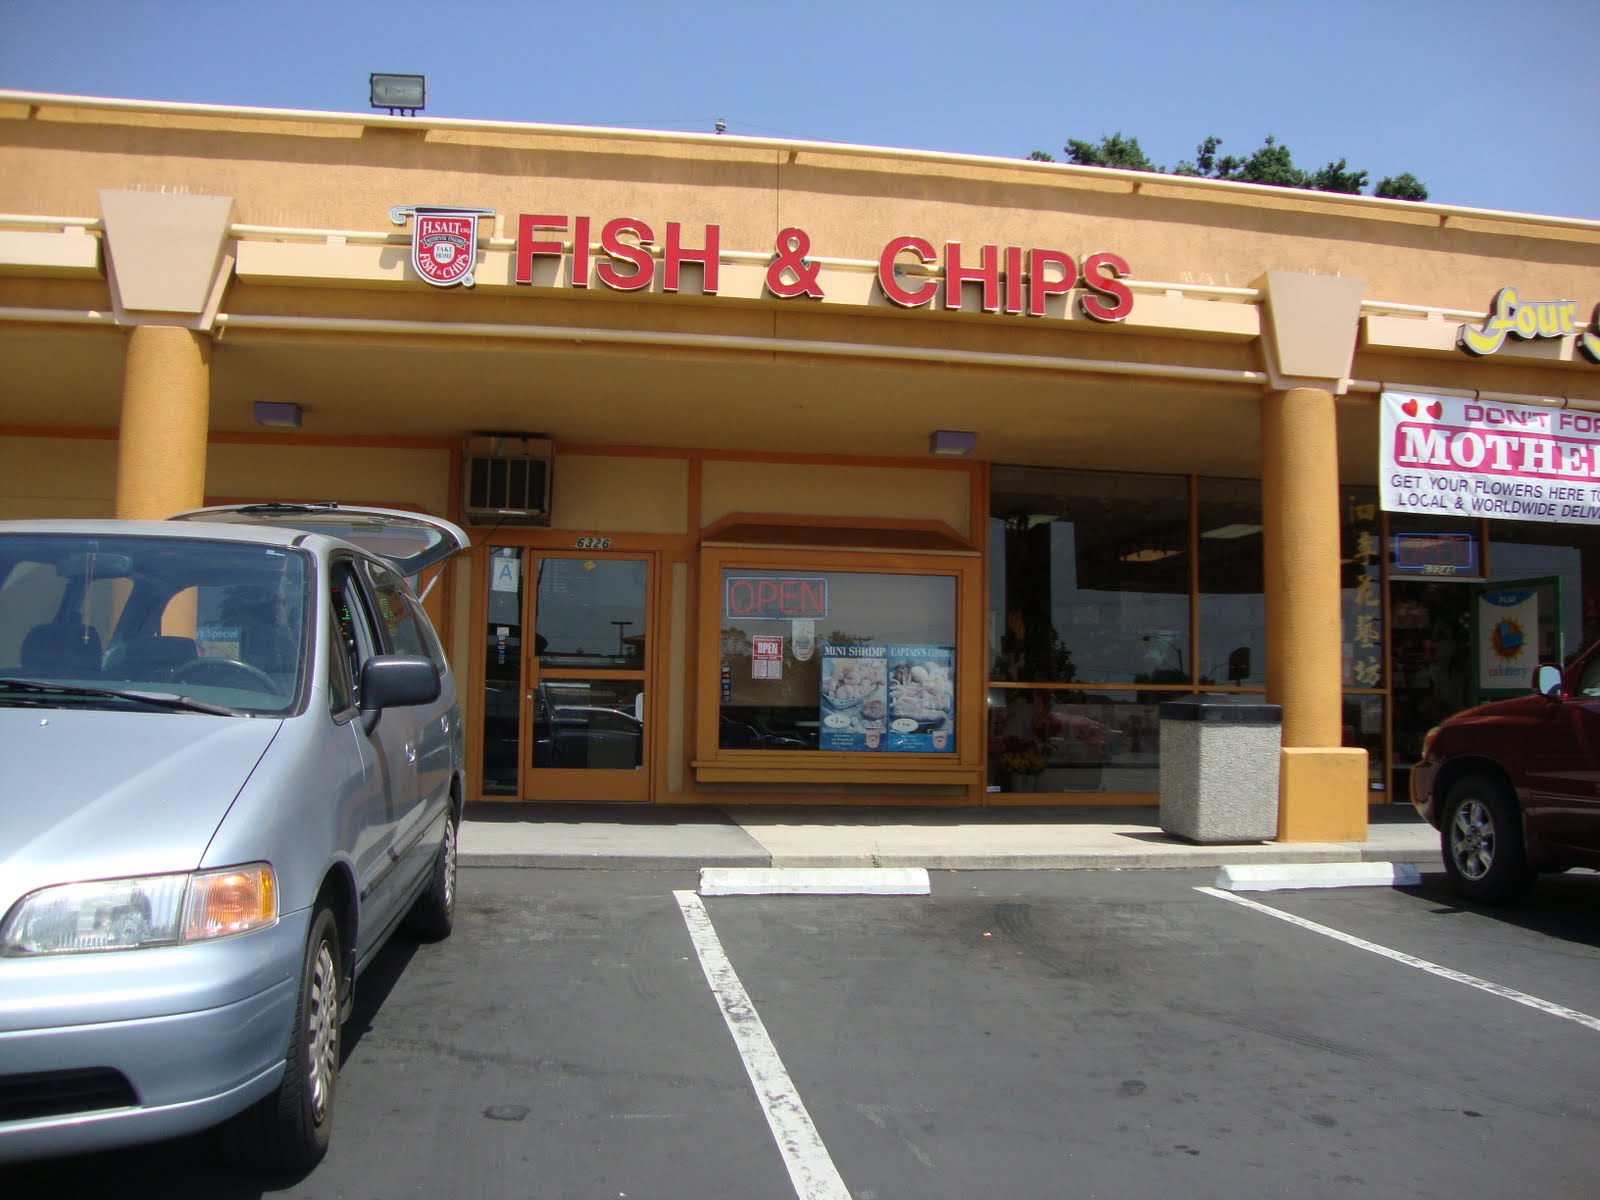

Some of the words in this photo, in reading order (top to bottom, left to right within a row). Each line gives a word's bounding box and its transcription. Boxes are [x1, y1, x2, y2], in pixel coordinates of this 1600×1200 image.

[436, 245, 453, 253] TAKE
[419, 253, 437, 276] FISH
[442, 254, 469, 278] CHIPS
[515, 213, 720, 294] FISH
[765, 226, 825, 299] &
[878, 235, 1134, 322] CHIPS
[1464, 404, 1549, 428] DON'T
[1400, 426, 1600, 477] MOTHE
[1391, 474, 1422, 489] GET
[1429, 476, 1469, 493] YOUR
[1474, 480, 1543, 499] FLOWERS
[1549, 486, 1585, 501] HERE
[1398, 492, 1448, 509] LOCAL
[1454, 496, 1464, 510] &
[1471, 497, 1557, 516] WORLDWIDE
[1561, 504, 1600, 519] DELIV
[576, 537, 611, 549] 6326
[499, 563, 513, 581] A
[730, 580, 824, 614] OPEN
[206, 629, 238, 640] Special
[757, 641, 779, 655] OPEN
[824, 646, 846, 656] MINI
[848, 646, 886, 656] SHRIMP
